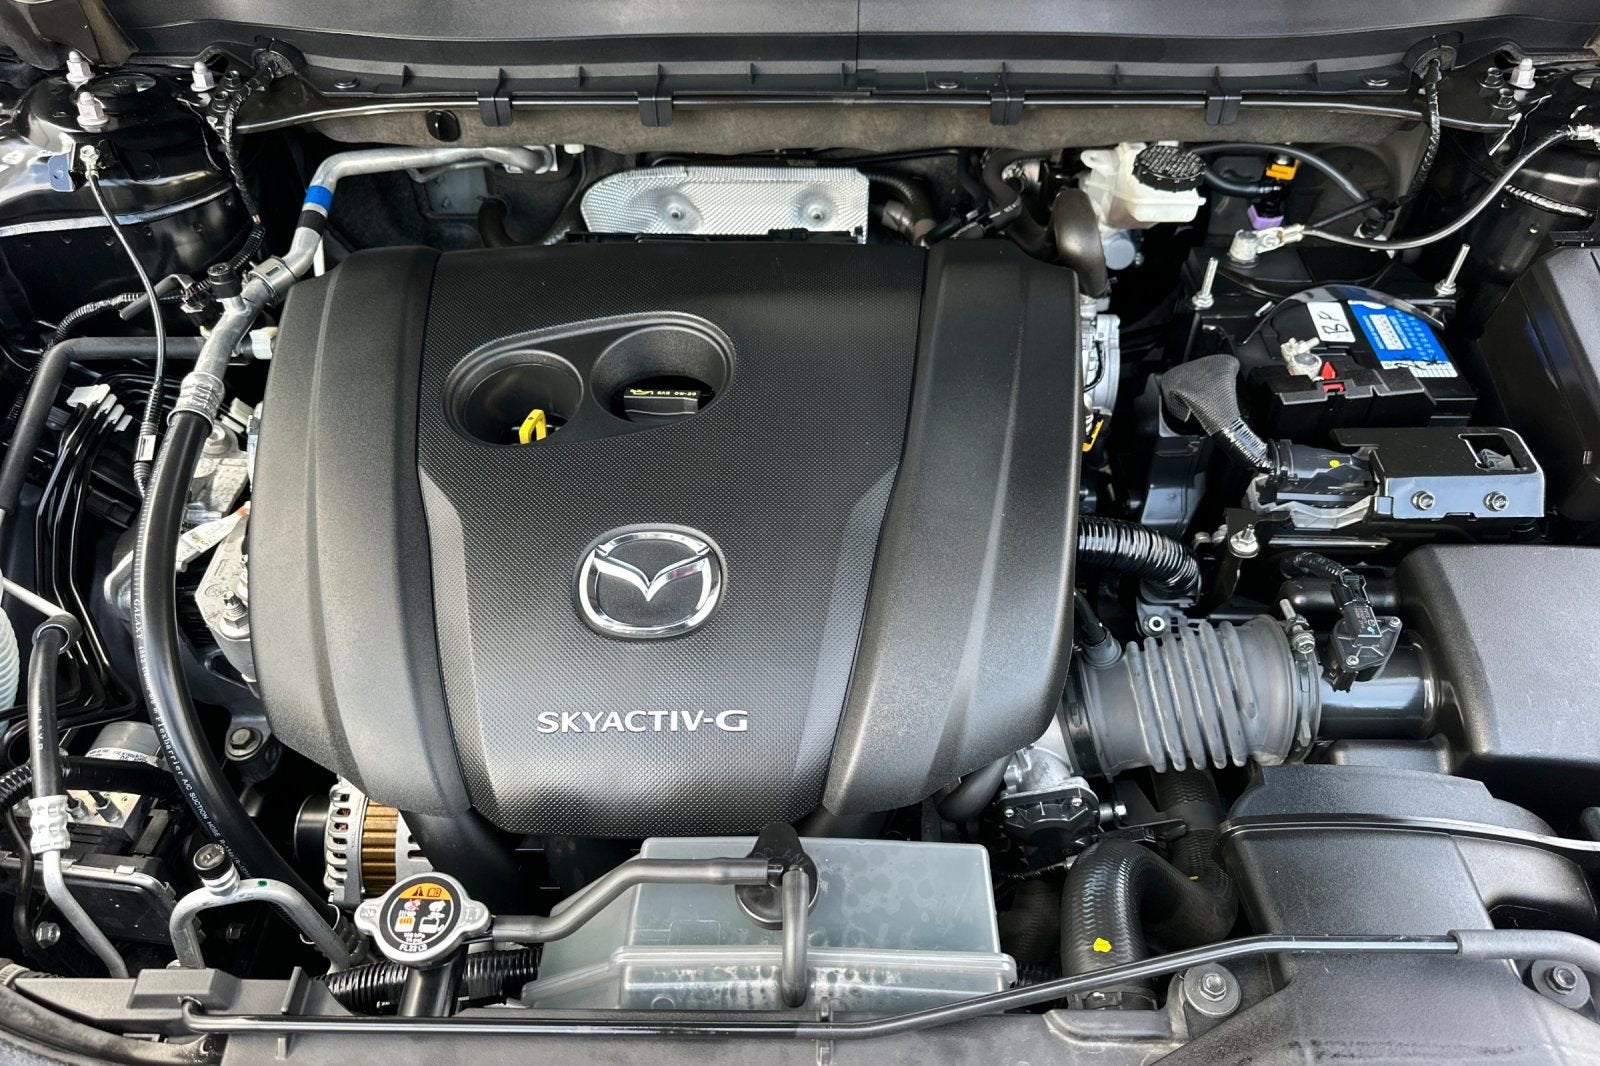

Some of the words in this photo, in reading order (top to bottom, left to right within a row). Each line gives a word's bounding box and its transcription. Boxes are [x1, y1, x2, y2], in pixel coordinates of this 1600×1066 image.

[134, 599, 144, 640] GALAXY
[536, 710, 749, 734] SKYACTIV-G
[182, 778, 193, 790] A/C
[189, 792, 209, 822] SUCTION
[206, 821, 221, 837] HOSE
